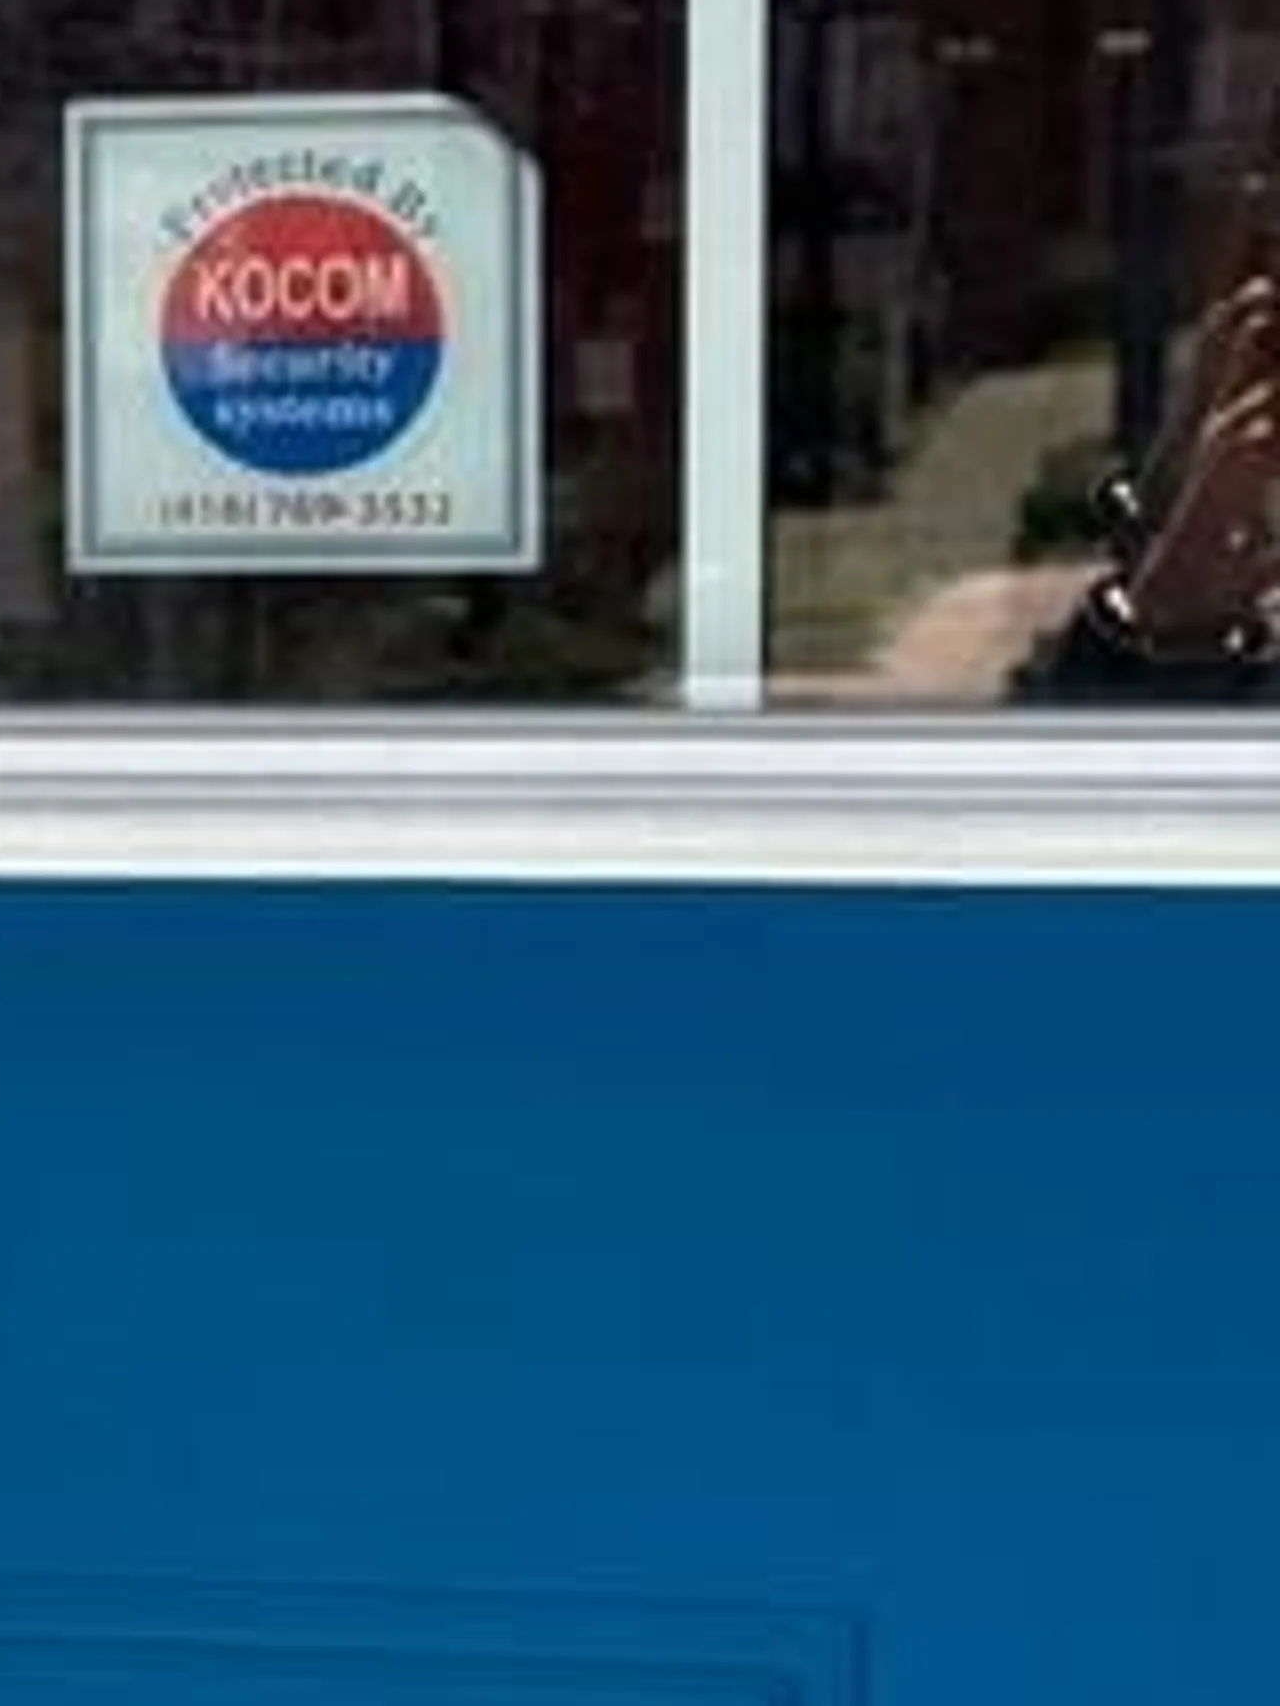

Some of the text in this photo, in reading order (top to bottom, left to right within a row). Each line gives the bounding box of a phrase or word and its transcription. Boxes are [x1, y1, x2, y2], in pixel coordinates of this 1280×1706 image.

[158, 148, 386, 241] Protected
[197, 255, 410, 322] KOCOM
[207, 342, 393, 392] Security
